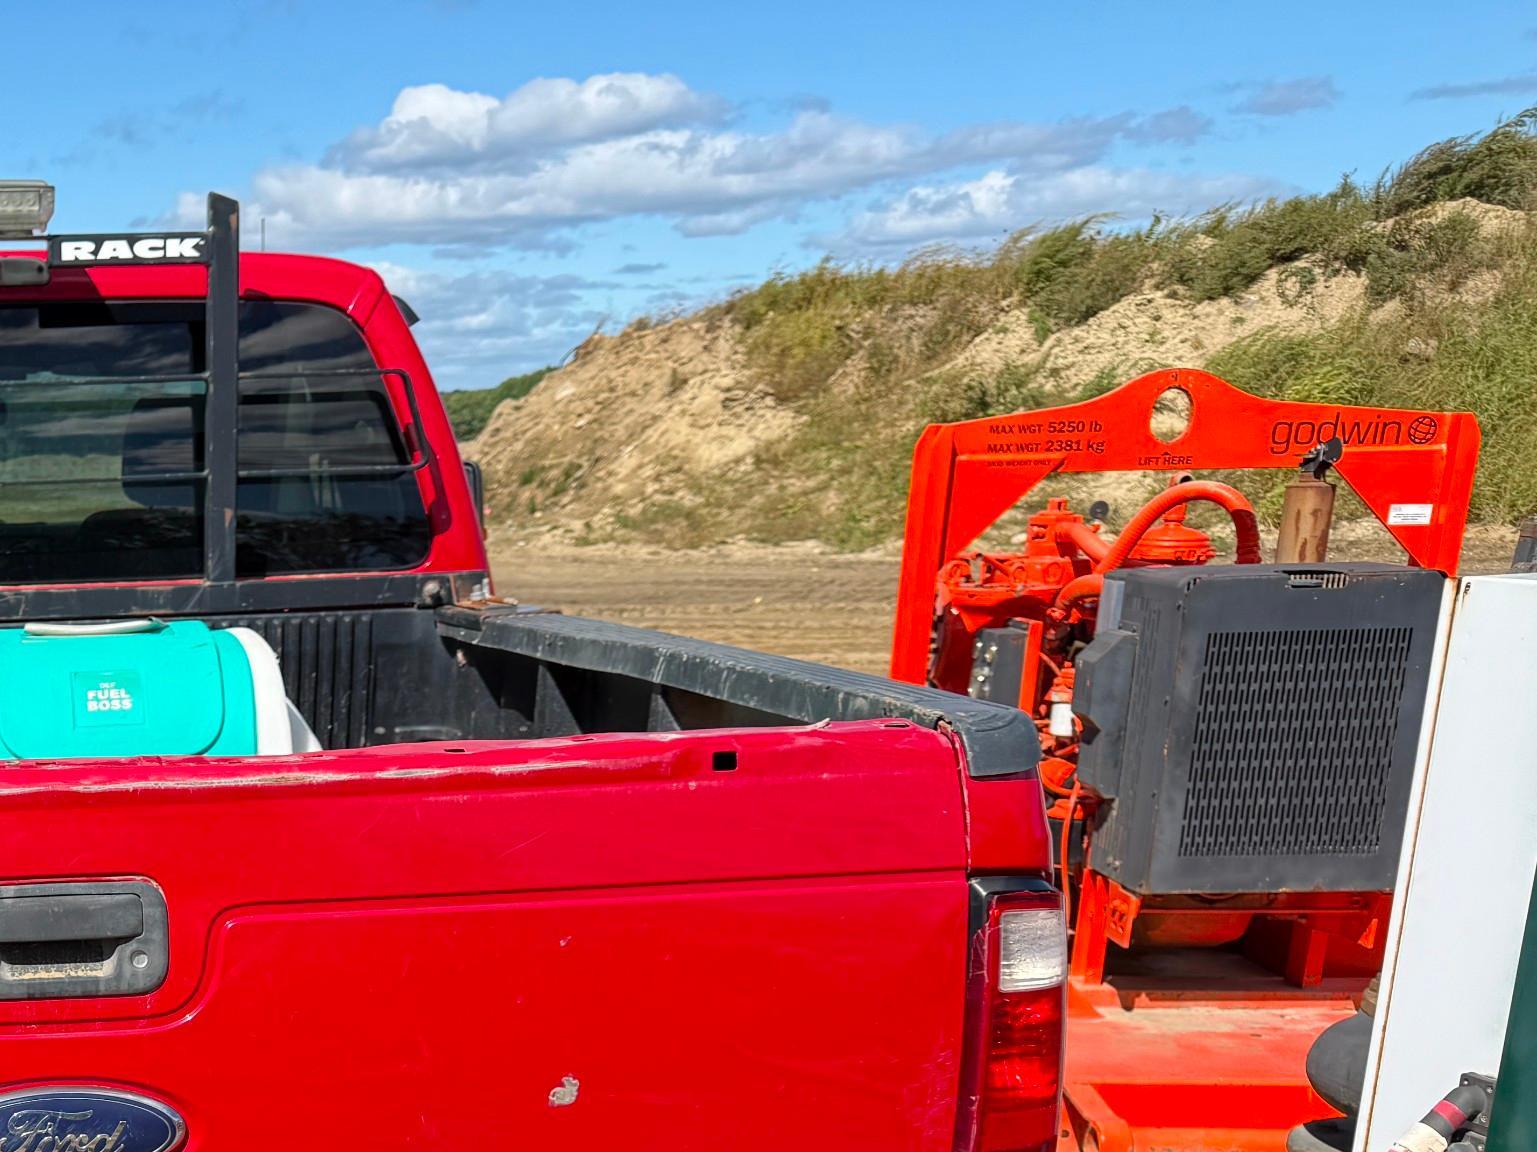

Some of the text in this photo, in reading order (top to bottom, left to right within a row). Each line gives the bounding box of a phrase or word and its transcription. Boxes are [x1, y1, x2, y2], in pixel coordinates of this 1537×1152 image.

[61, 238, 202, 261] RACK
[989, 420, 1103, 433] MAX WGT 5250 lb
[1270, 412, 1402, 455] godwin
[987, 439, 1106, 455] MAX WGT 2381 kg
[1138, 455, 1192, 466] LIFT HERE
[87, 688, 131, 700] FUEL
[87, 699, 133, 712] BOSS
